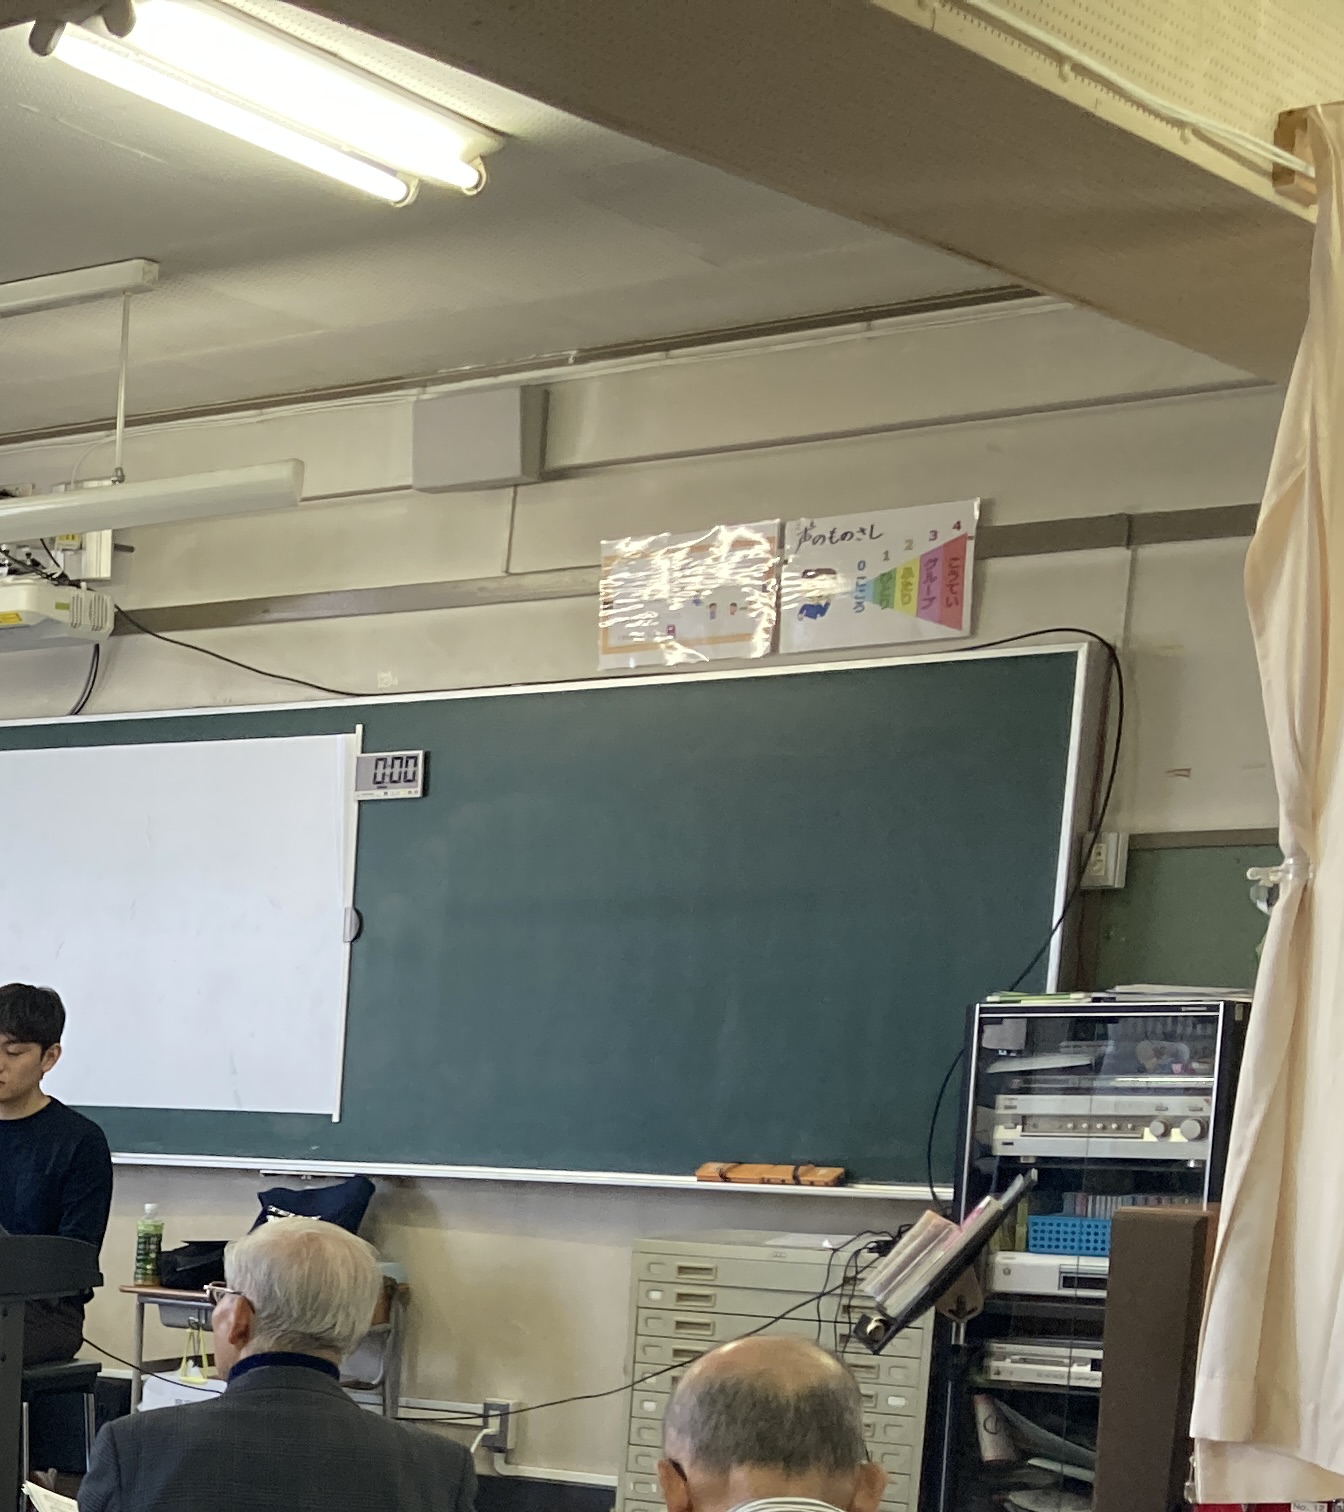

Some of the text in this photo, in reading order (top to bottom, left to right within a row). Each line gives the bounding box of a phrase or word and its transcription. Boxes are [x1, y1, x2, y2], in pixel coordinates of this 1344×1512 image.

[952, 521, 962, 531] 4
[795, 524, 884, 554] 声のものさし
[929, 530, 938, 541] 3
[883, 551, 890, 561] 1
